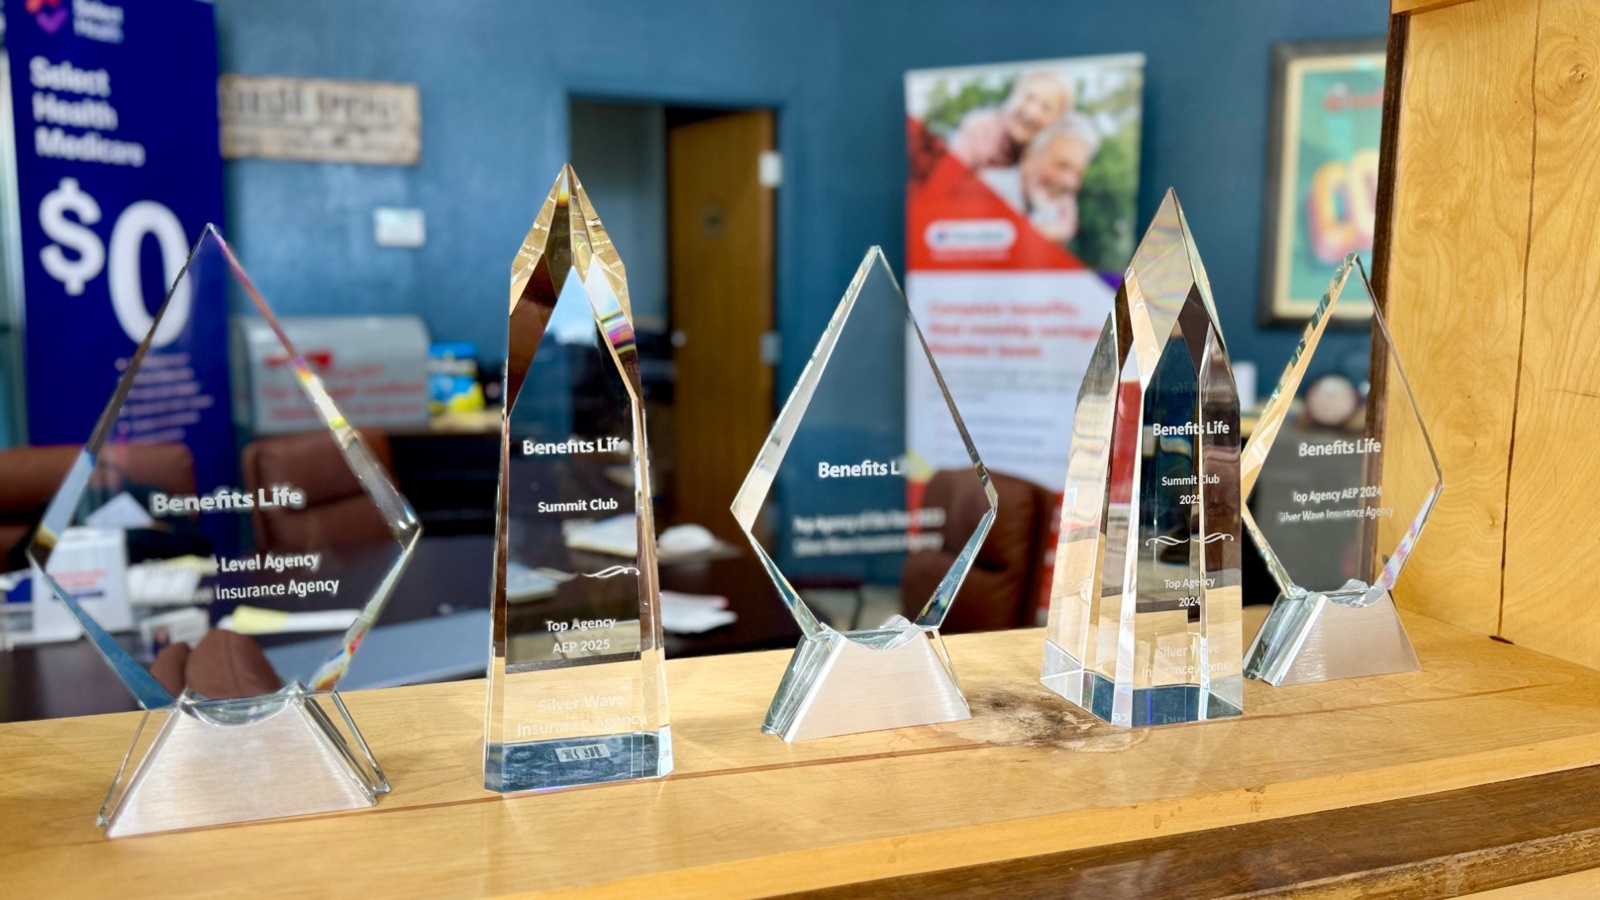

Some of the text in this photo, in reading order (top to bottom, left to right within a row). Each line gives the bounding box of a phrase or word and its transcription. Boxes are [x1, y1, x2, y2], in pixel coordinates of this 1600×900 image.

[29, 55, 112, 98] Select
[32, 91, 119, 132] Health
[35, 126, 146, 167] Medicare
[39, 178, 192, 348] $0
[1152, 421, 1230, 436] Benefits Life
[523, 438, 595, 455] Benefits
[1298, 438, 1381, 457] Benefits Life
[818, 459, 888, 478] Benefits
[1161, 473, 1220, 486] Summit Club
[152, 487, 303, 513] Benefits Life
[1179, 494, 1201, 505] 2025
[1309, 490, 1340, 503] Agency
[1341, 487, 1358, 499] AEP
[1360, 486, 1383, 498] 2024
[538, 498, 618, 513] Summit Club
[1302, 510, 1324, 521] Wave
[1326, 509, 1364, 519] Insurance
[1366, 506, 1394, 519] Agency
[220, 554, 260, 573] Level
[264, 552, 320, 573] Agency
[215, 581, 285, 600] Insurance
[288, 579, 339, 598] Agency
[1164, 577, 1215, 590] Top Agency
[1178, 597, 1201, 608] 2024
[546, 618, 616, 632] Top Agency
[553, 639, 610, 654] AEP 2025
[540, 694, 625, 712] Silver Wave
[595, 713, 647, 731] Agency
